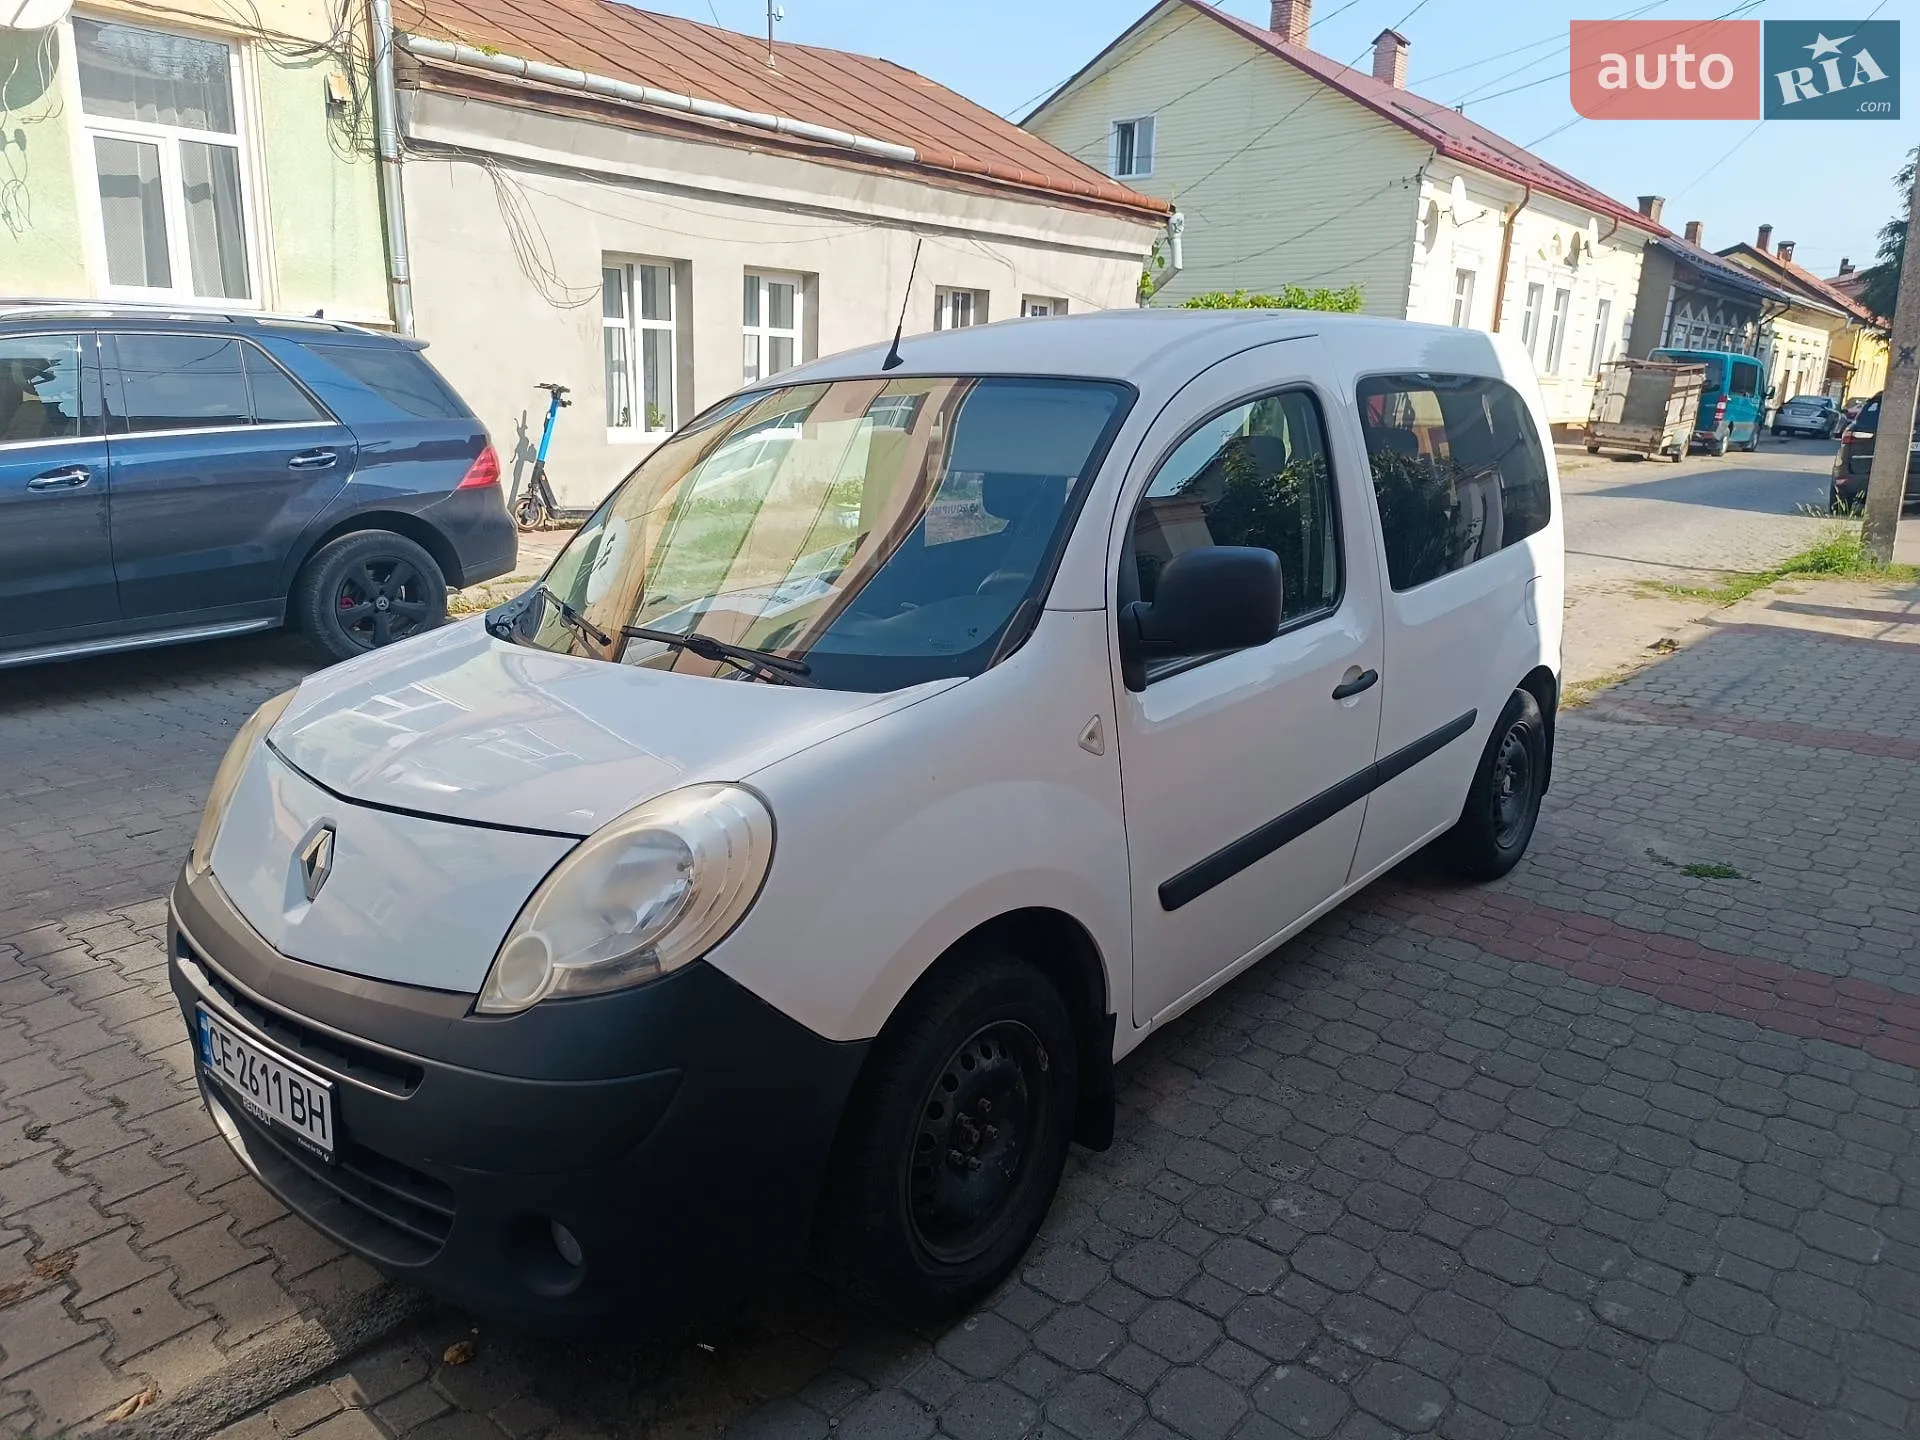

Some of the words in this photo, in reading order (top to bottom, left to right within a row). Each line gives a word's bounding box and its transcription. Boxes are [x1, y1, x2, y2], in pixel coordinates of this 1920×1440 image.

[209, 1026, 235, 1080] CE
[236, 1046, 285, 1115] 2611
[288, 1077, 327, 1141] BH
